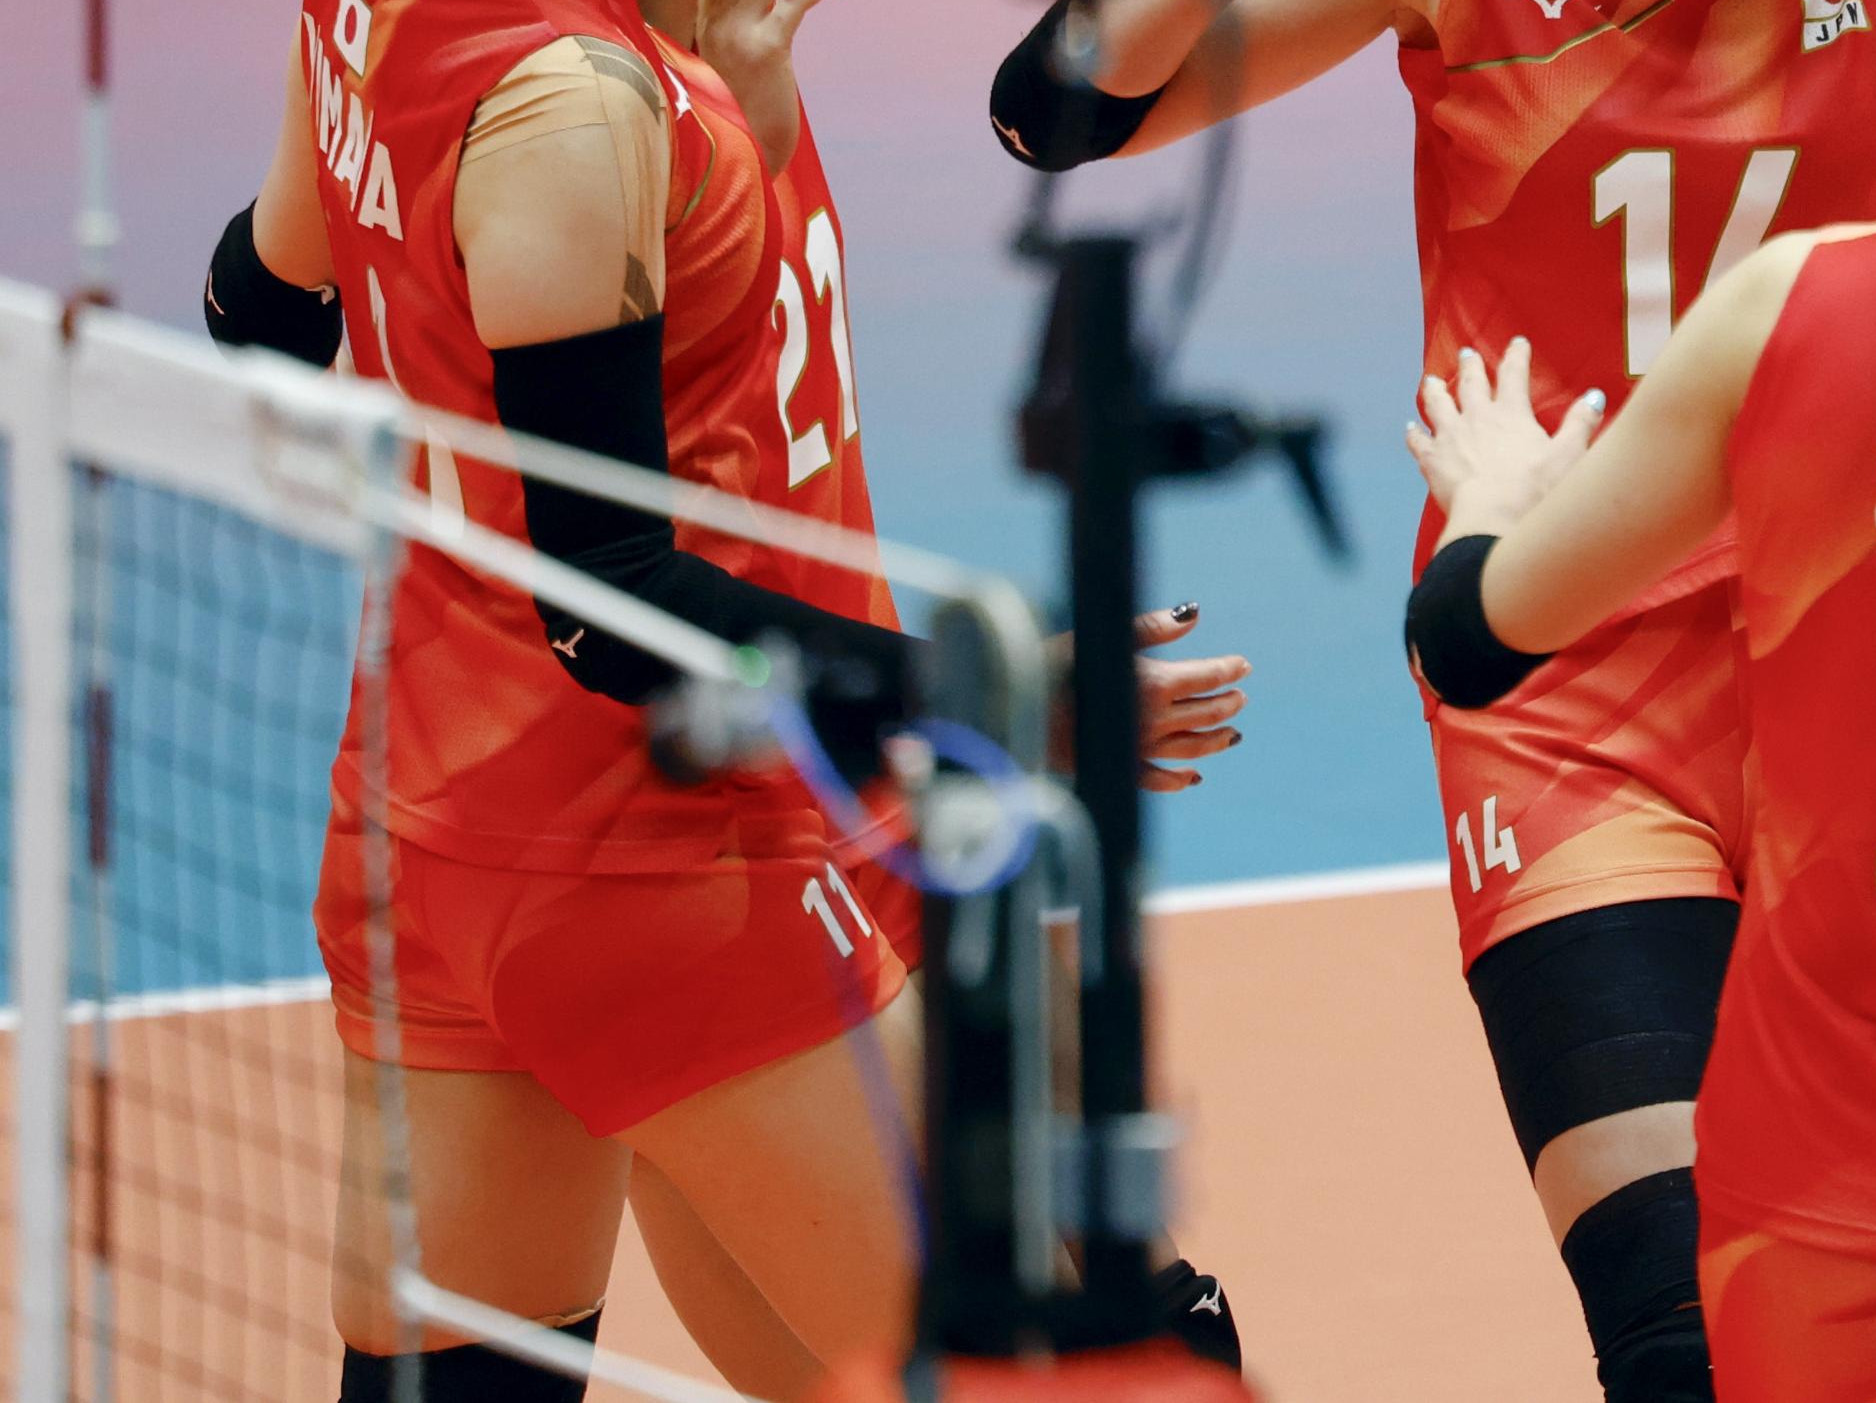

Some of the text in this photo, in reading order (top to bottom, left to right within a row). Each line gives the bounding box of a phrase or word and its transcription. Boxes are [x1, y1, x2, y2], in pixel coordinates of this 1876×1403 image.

[1816, 2, 1859, 42] JPN
[771, 206, 860, 489] 21
[1455, 795, 1522, 893] 14
[801, 861, 872, 958] 11
